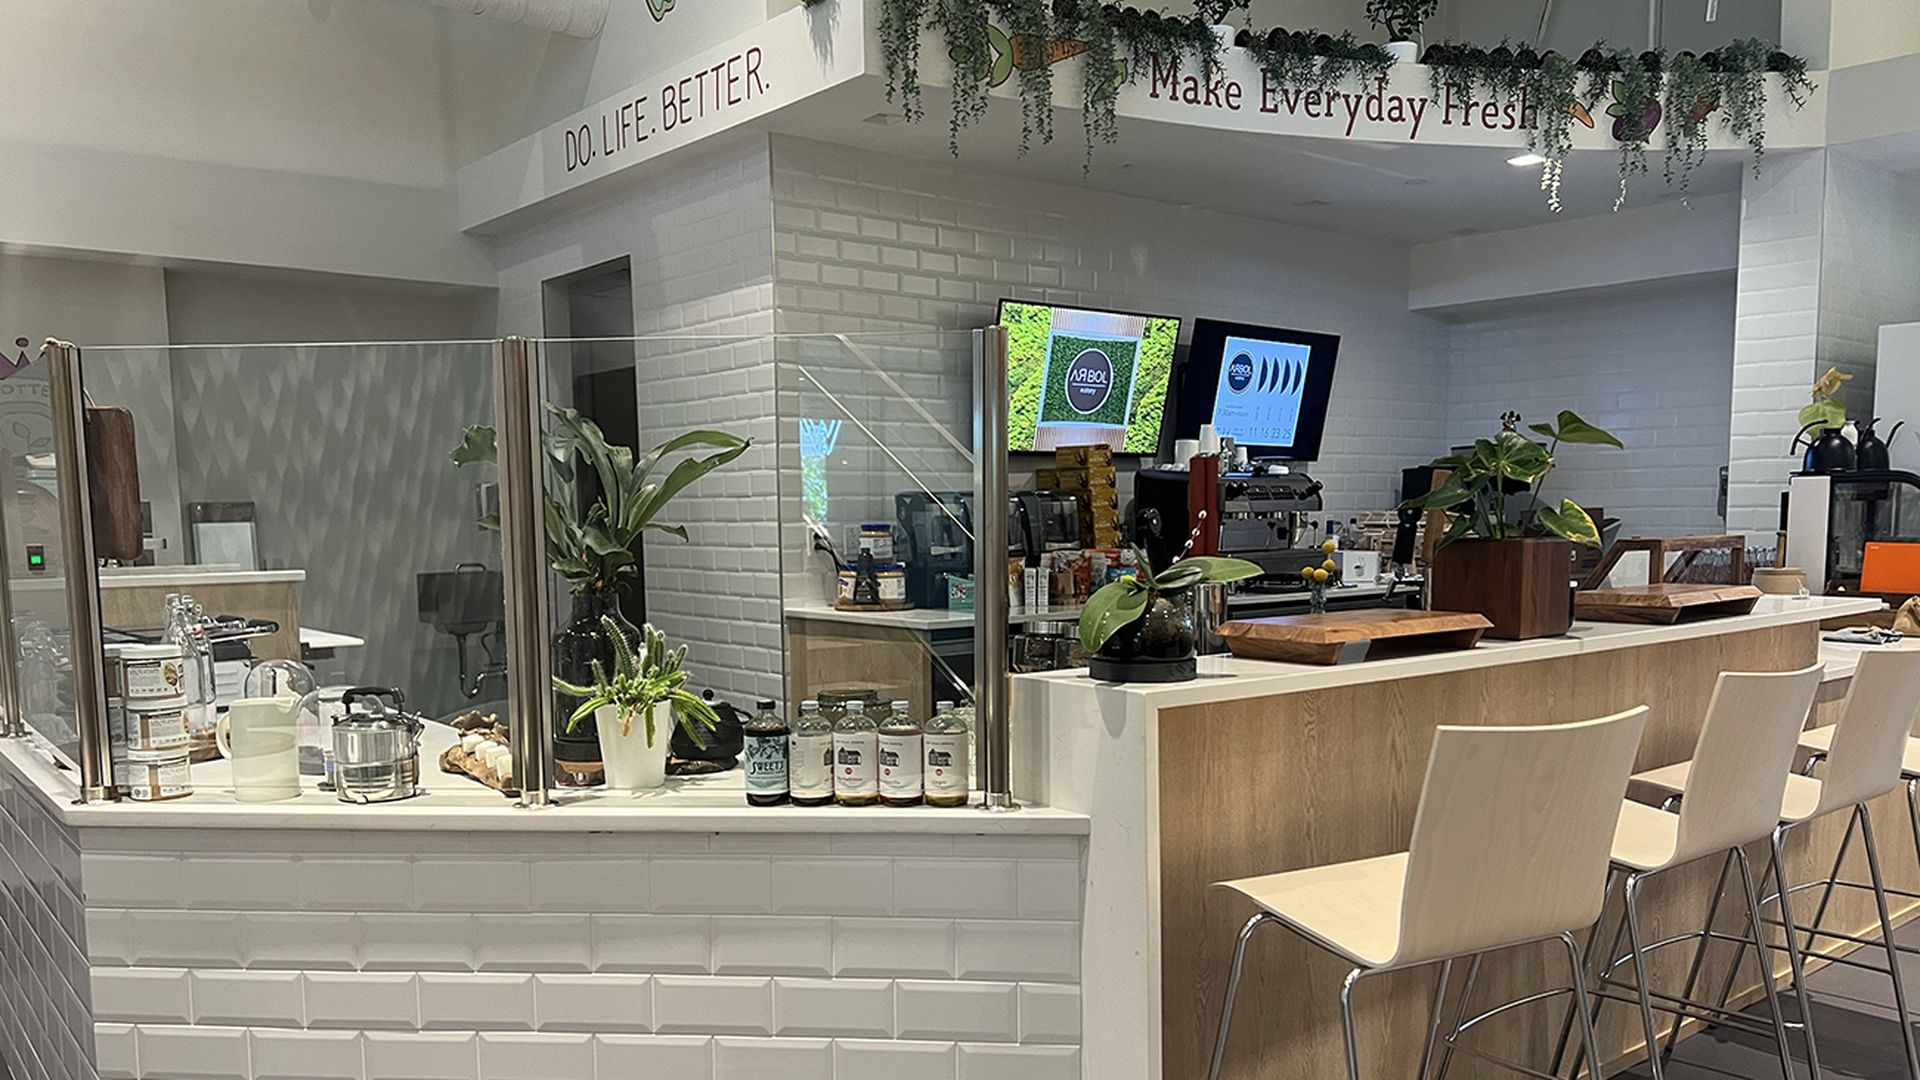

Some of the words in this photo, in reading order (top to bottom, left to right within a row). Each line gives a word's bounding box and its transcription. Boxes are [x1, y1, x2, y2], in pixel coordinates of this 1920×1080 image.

[565, 124, 596, 172] DO.
[602, 96, 656, 156] LIFE.
[662, 47, 770, 131] BETTER.
[1149, 54, 1242, 111] Make
[1260, 67, 1429, 140] Everyday
[1442, 80, 1539, 130] Fresh
